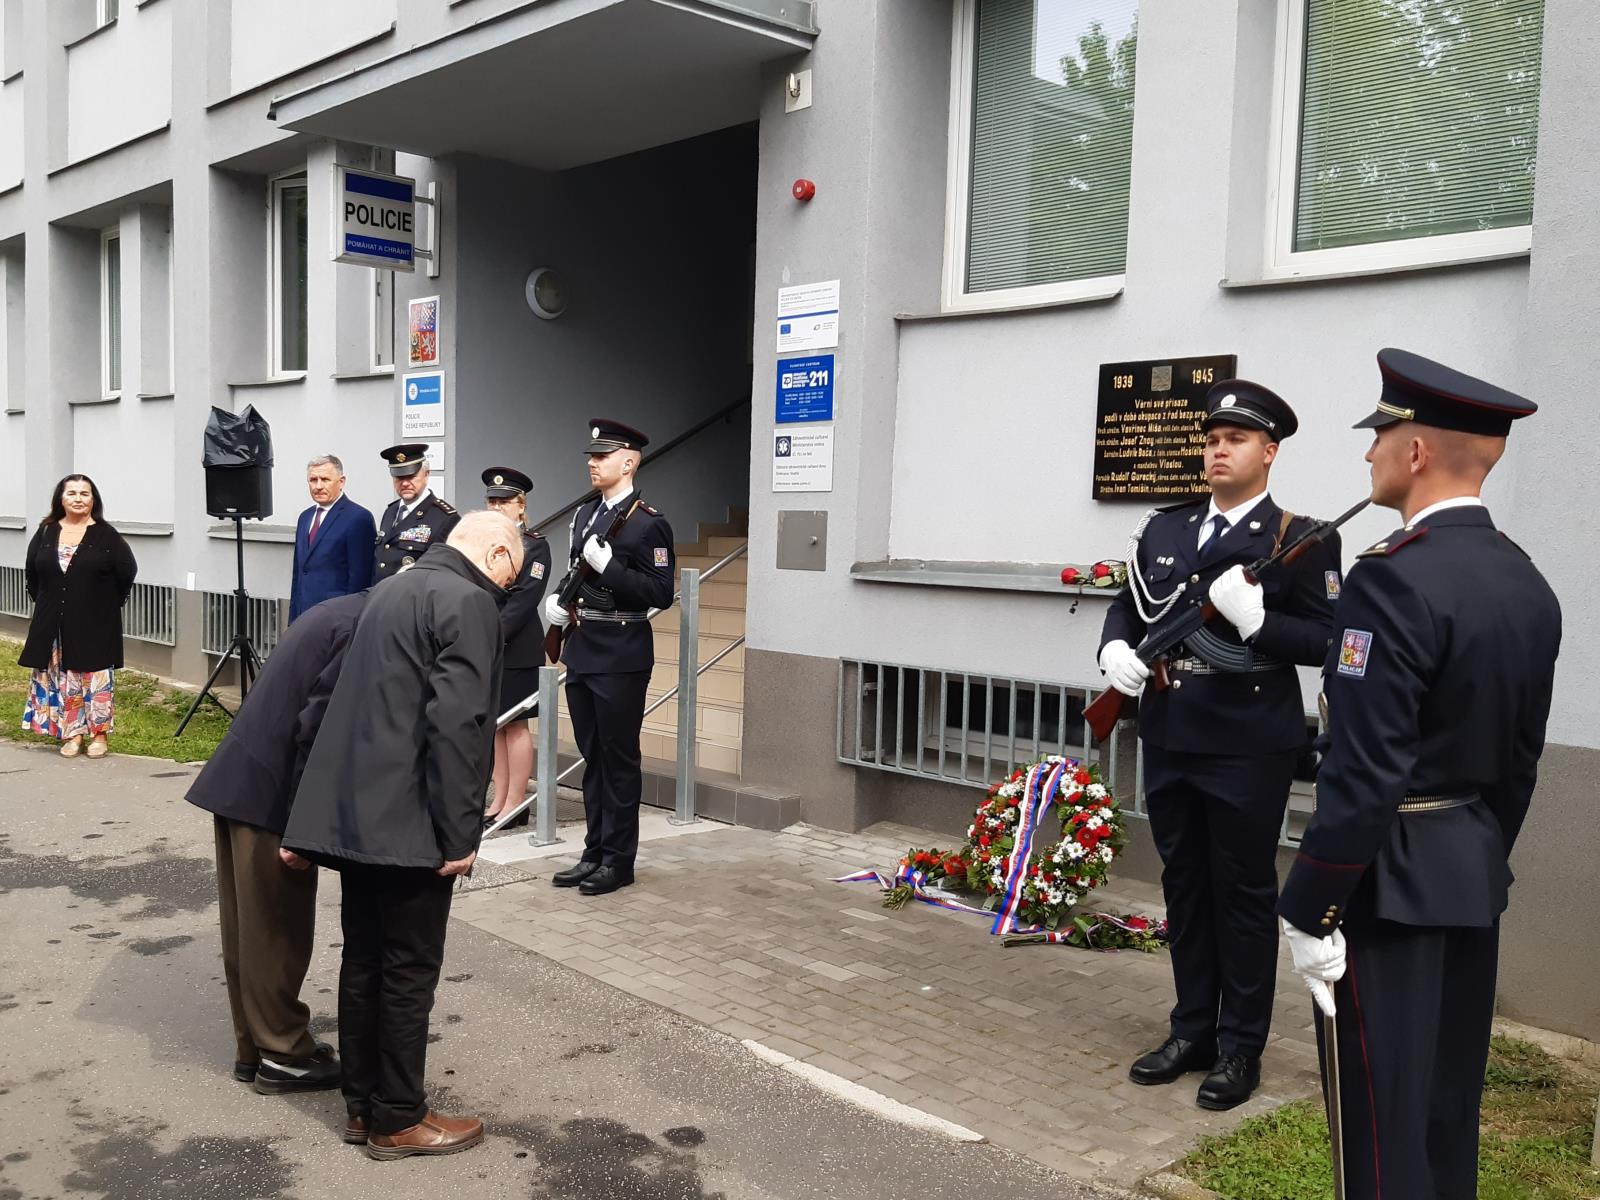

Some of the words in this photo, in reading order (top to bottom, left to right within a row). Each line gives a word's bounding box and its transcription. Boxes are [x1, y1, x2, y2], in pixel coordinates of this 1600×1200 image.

[345, 202, 412, 232] POLICIE
[347, 239, 377, 251] POMÁHAT
[809, 369, 829, 388] 211
[1113, 375, 1133, 389] 1939
[1192, 368, 1213, 384] 1945
[1138, 411, 1161, 422] okupace
[1120, 436, 1138, 446] Josef
[1110, 471, 1130, 482] Rudolf
[1114, 483, 1127, 493] Ivan
[1339, 664, 1363, 673] POLICIE
